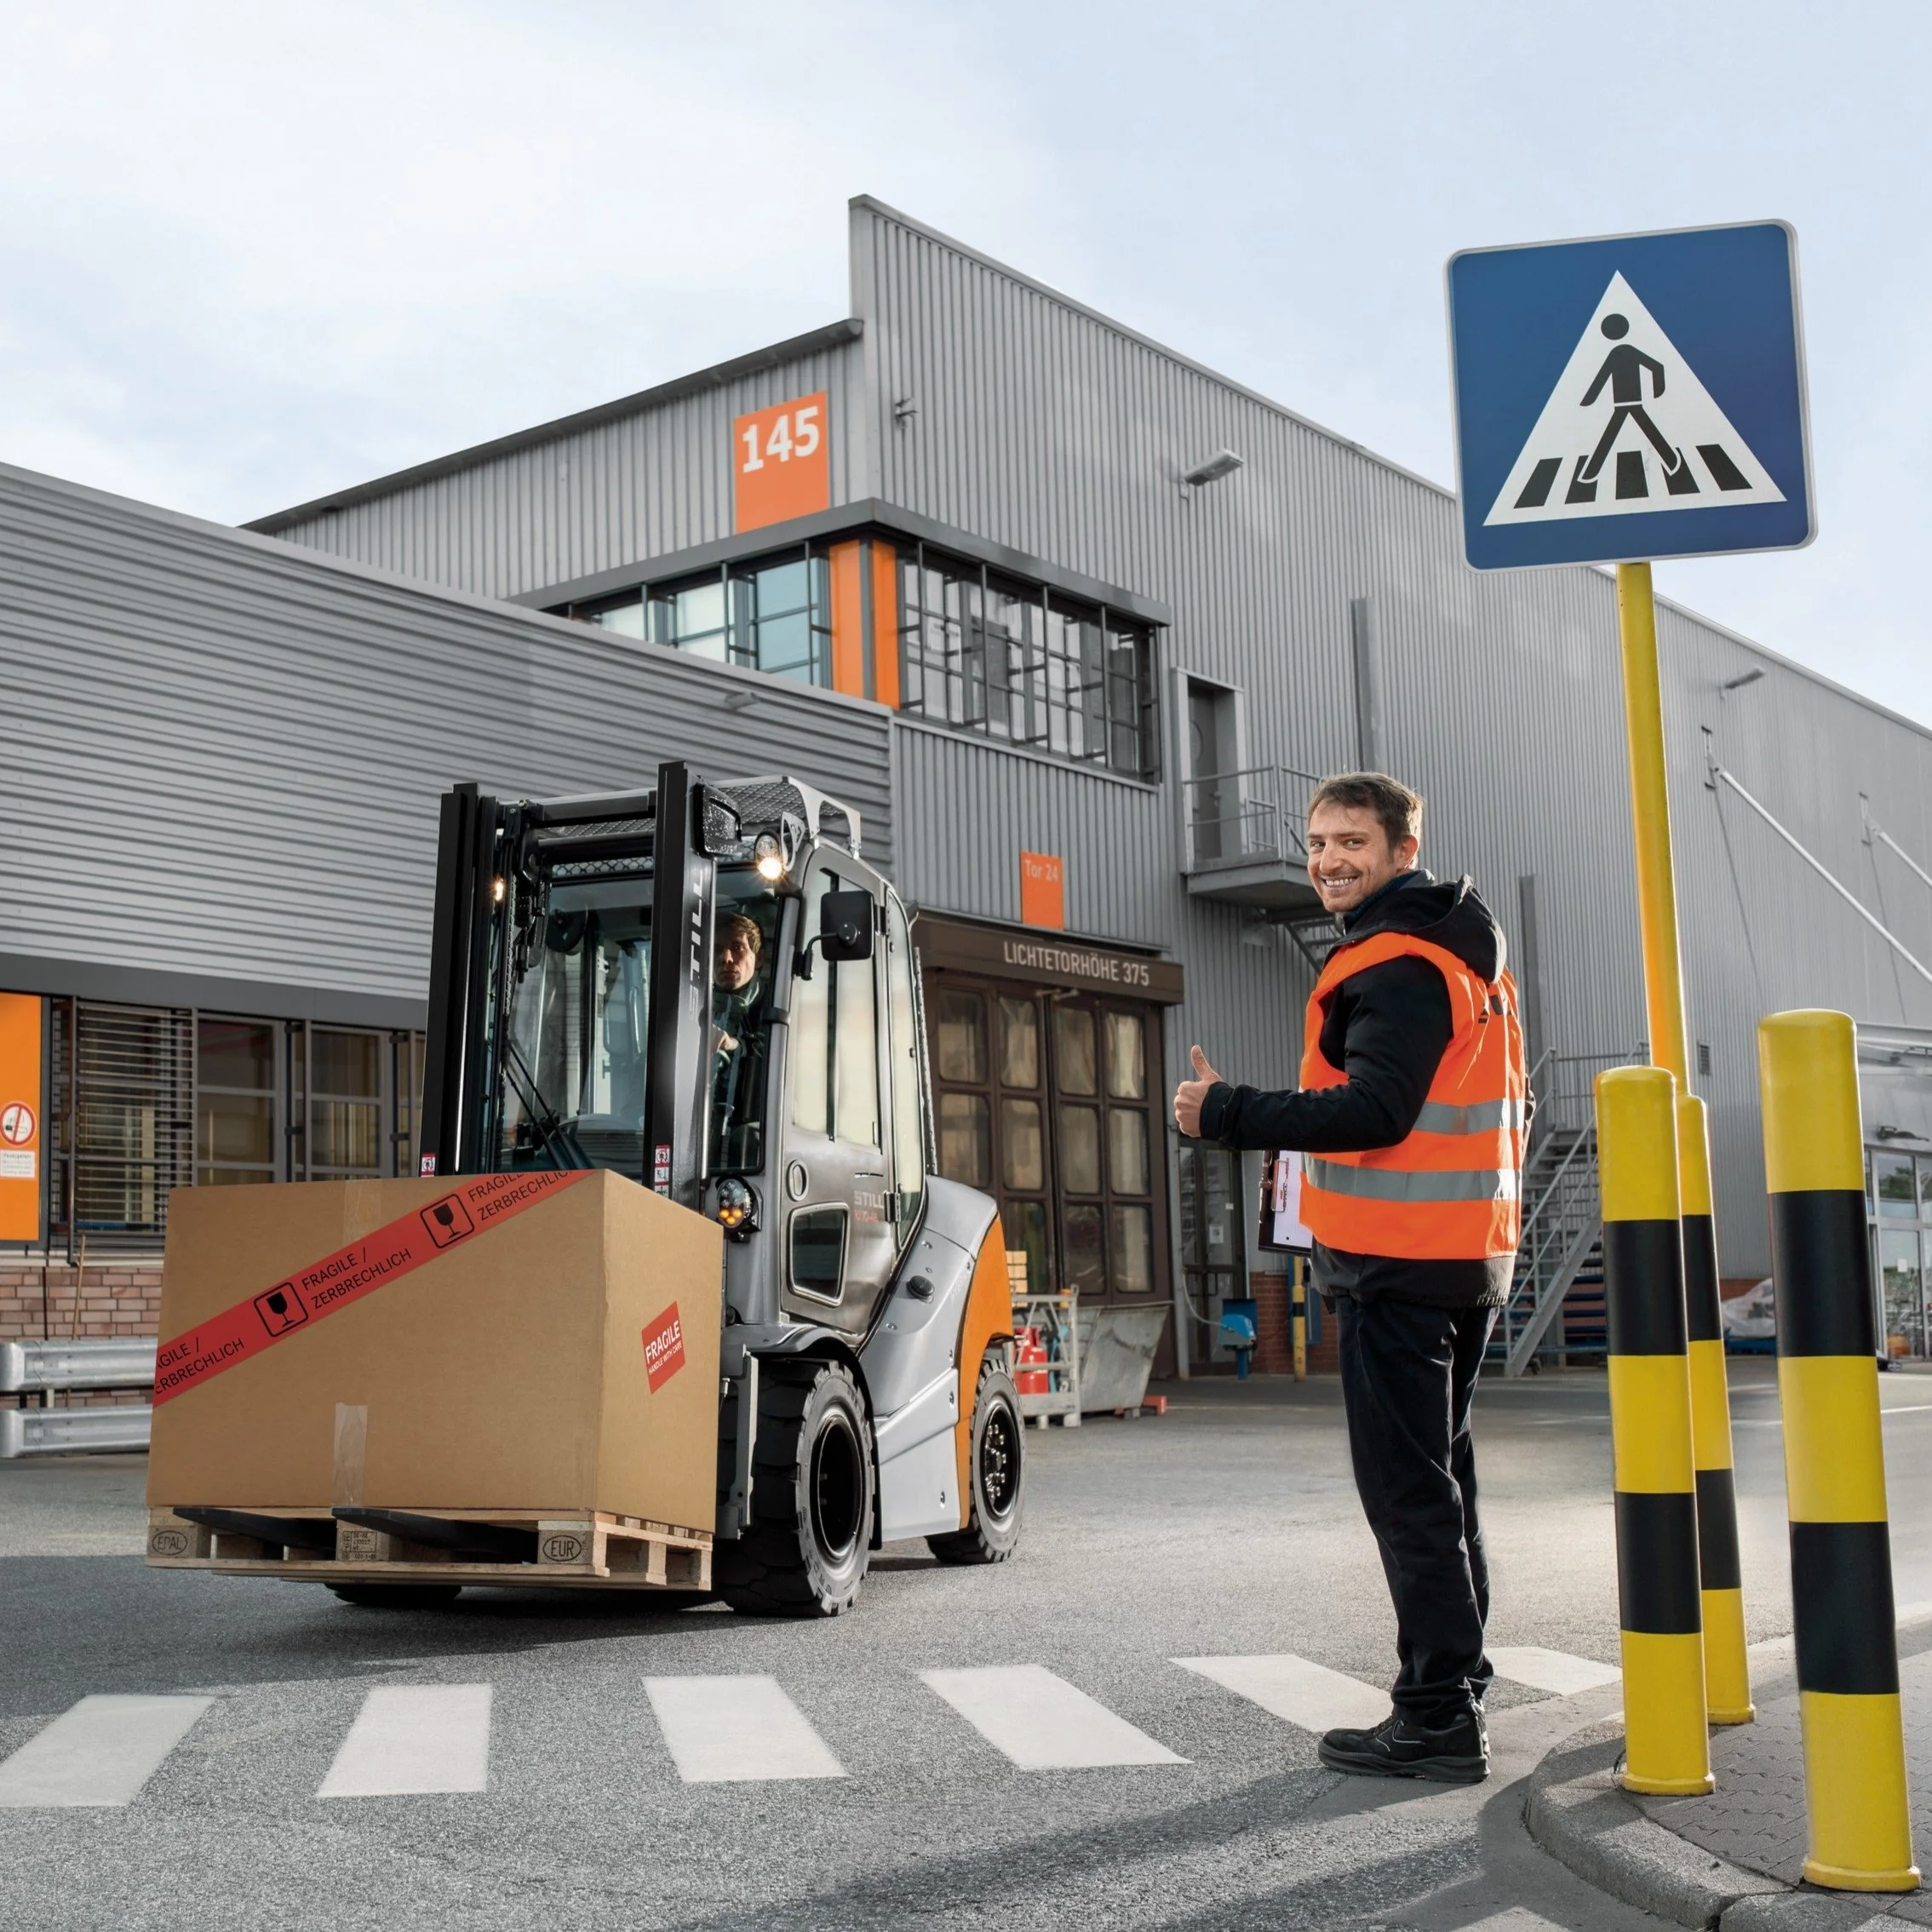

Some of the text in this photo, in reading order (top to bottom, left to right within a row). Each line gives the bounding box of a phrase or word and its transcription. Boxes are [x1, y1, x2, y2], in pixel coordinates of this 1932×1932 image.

[742, 405, 820, 473] 145
[1024, 859, 1059, 882] Tor 24
[690, 869, 703, 1020] STILL
[1003, 941, 1149, 986] LICHTETORHÖHE 375
[477, 1171, 572, 1221] ZERBRECHLIC
[854, 1190, 885, 1209] STILL
[301, 1253, 358, 1292] FRAGILE
[310, 1247, 413, 1310] ZERBRECHLICH
[645, 1320, 681, 1364] FRAGILE
[648, 1340, 682, 1376] HANDLE WITH CARE
[158, 1536, 182, 1551] EPAL
[551, 1539, 576, 1557] EUR
